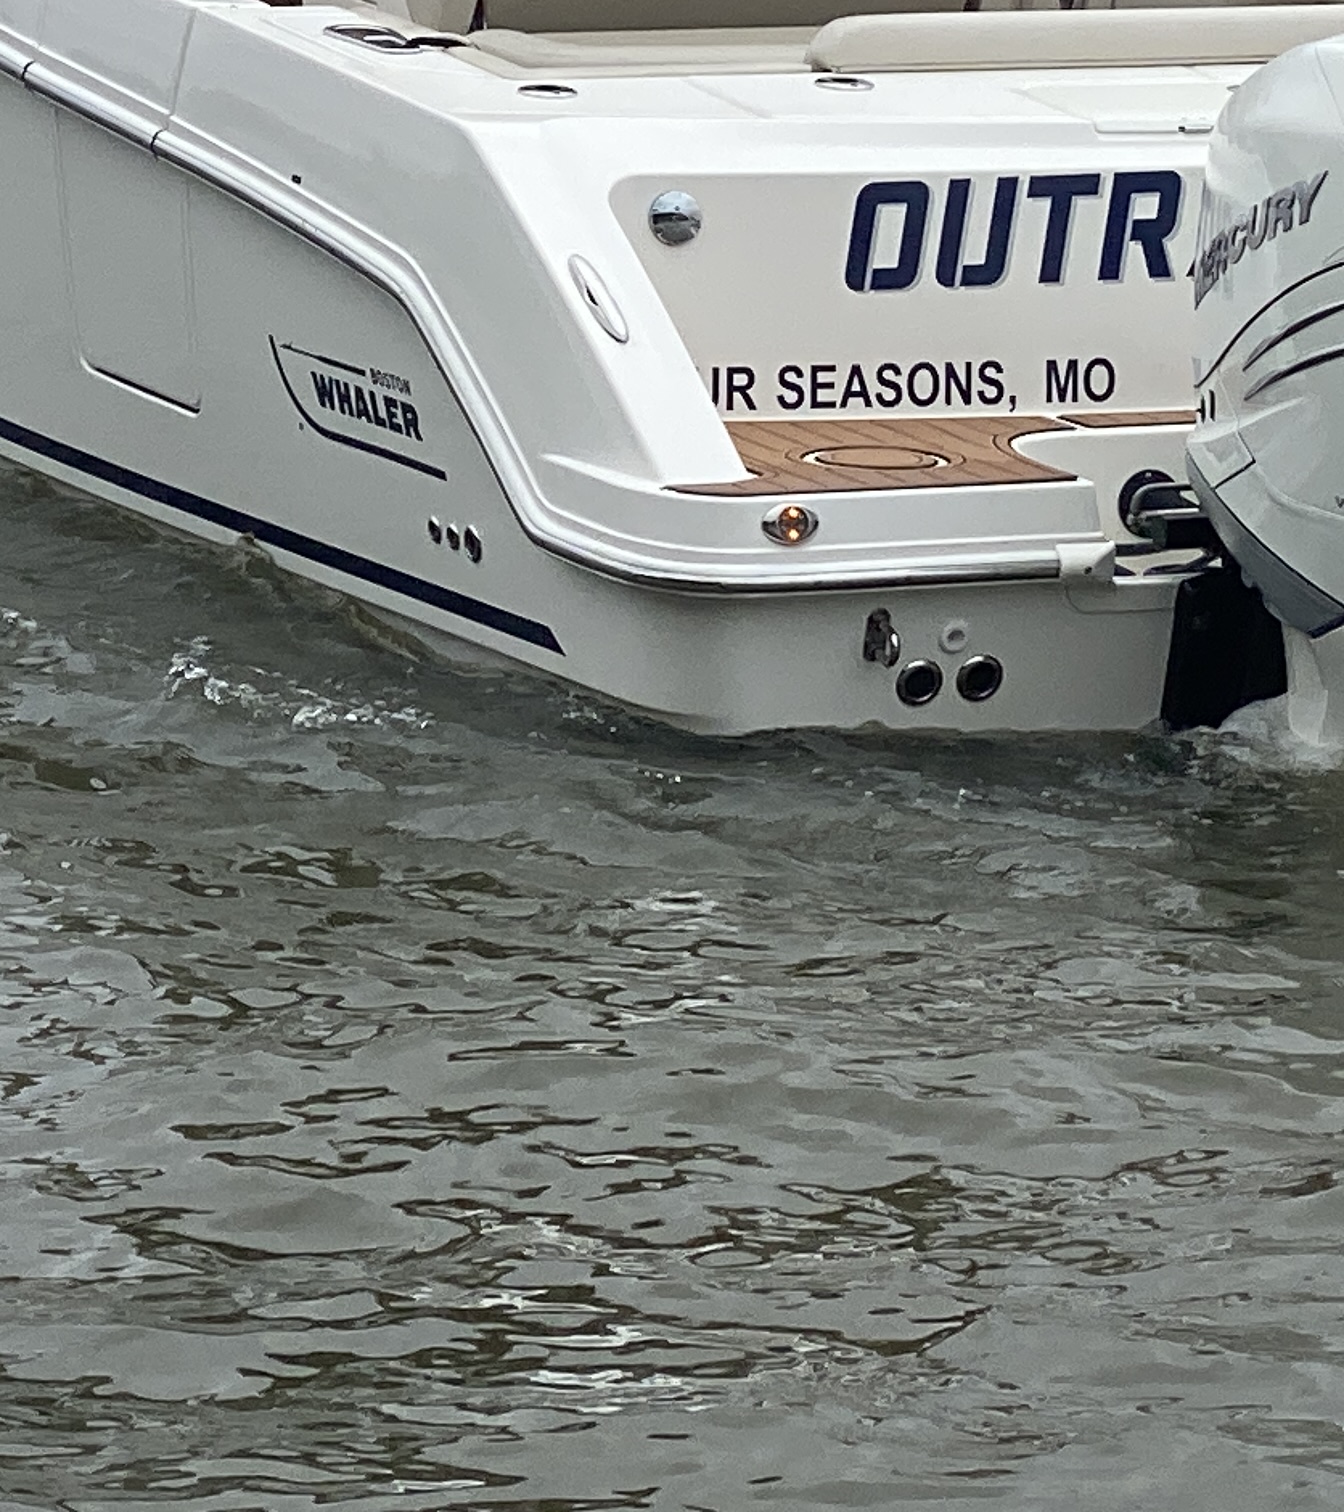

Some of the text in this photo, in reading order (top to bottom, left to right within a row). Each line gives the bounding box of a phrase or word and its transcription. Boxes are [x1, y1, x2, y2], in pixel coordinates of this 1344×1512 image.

[844, 170, 1197, 292] OUTR
[311, 371, 424, 442] WHALER
[776, 361, 1017, 414] SEASONS,
[1046, 357, 1116, 403] MO
